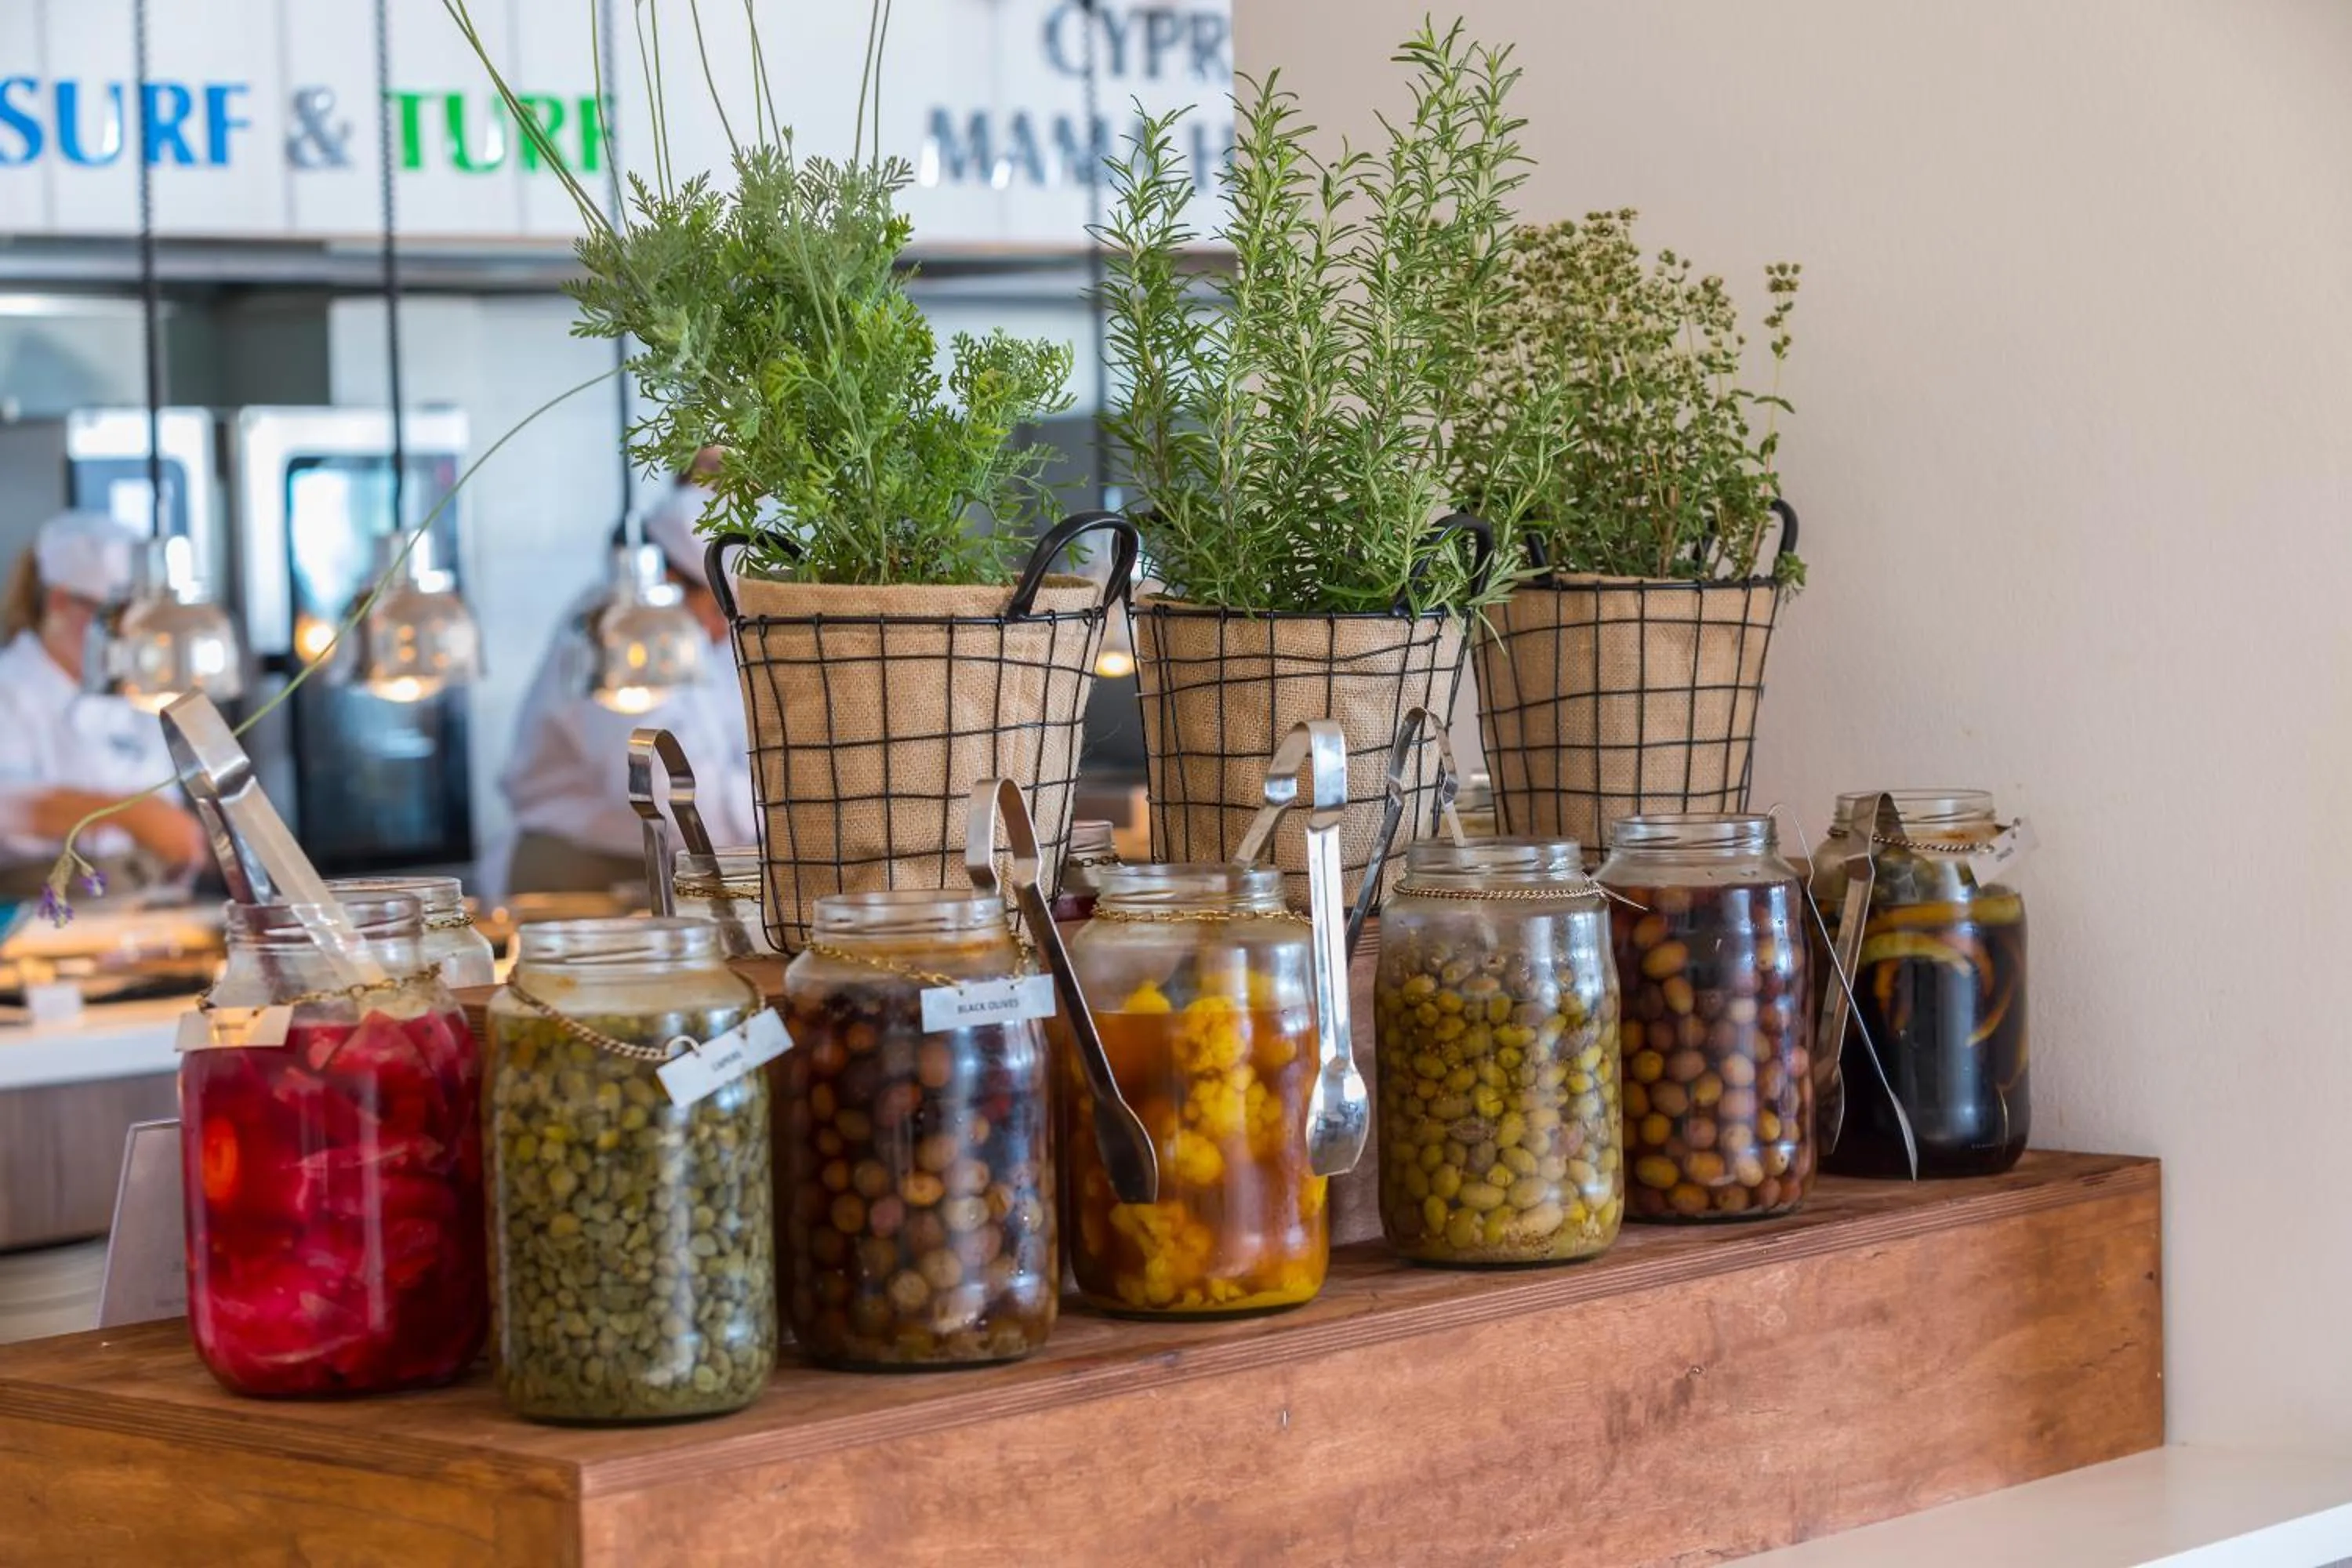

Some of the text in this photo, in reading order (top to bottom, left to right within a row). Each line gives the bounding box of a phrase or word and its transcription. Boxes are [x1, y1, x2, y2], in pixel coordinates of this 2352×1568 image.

[0, 75, 618, 173] SURF & TURF
[957, 1002, 985, 1015] BLACK
